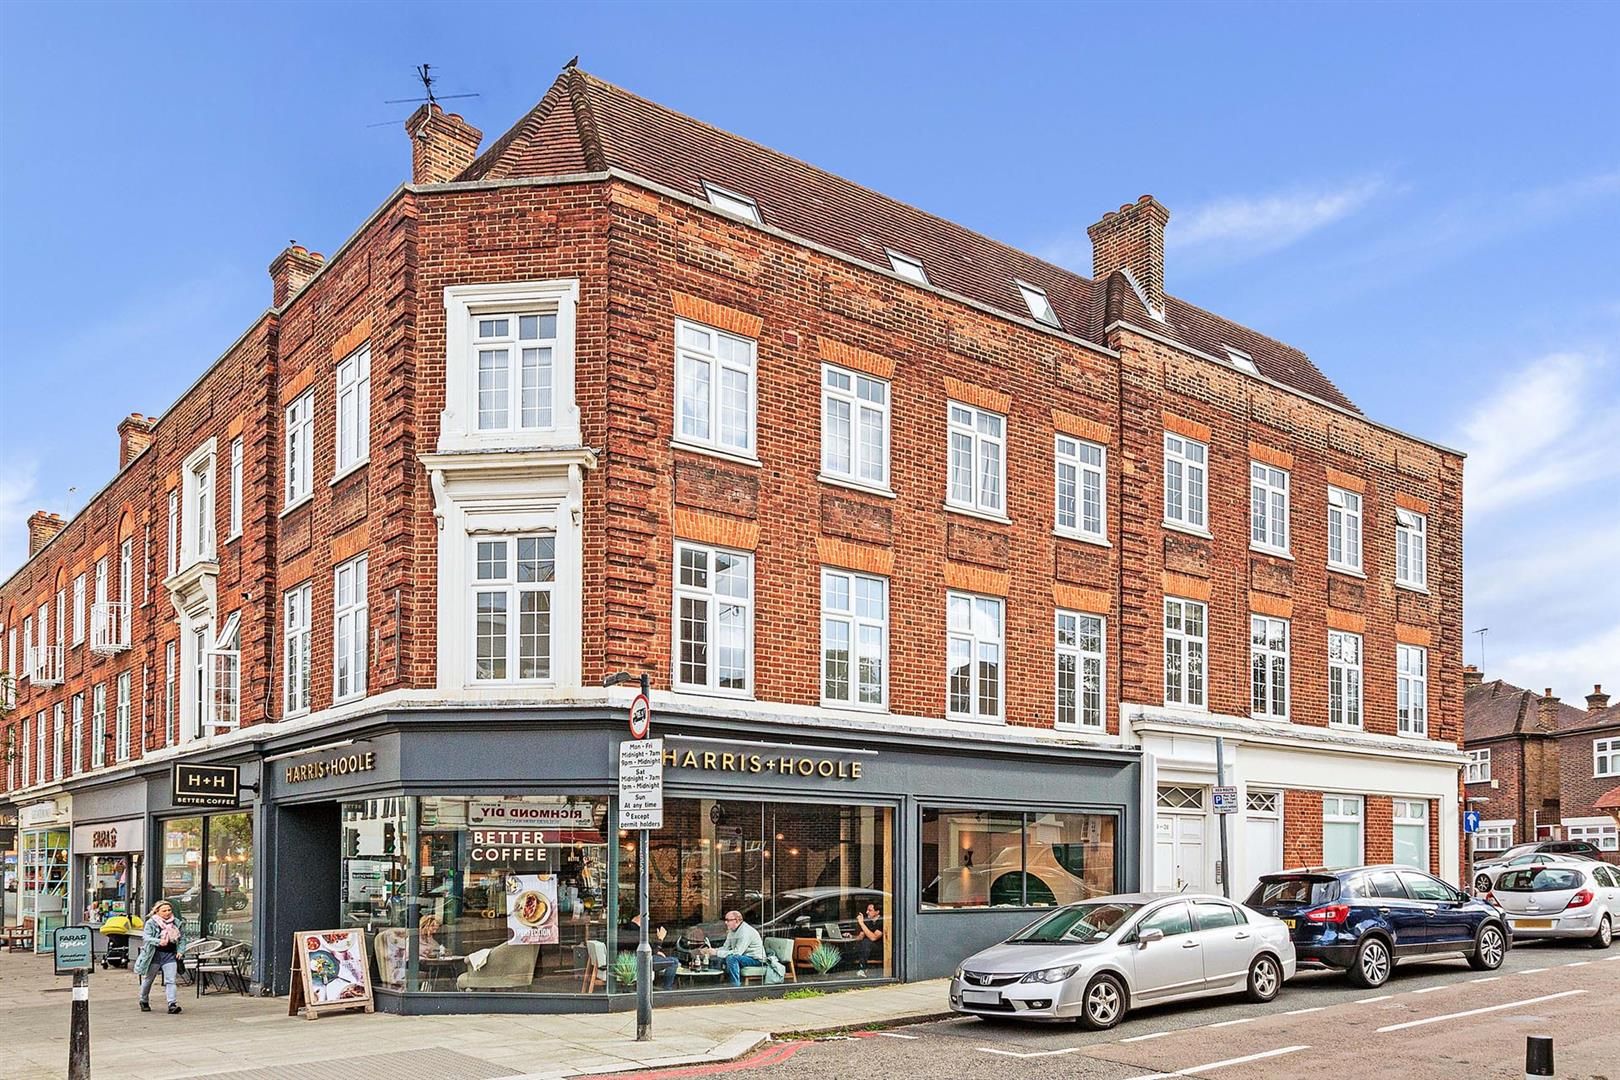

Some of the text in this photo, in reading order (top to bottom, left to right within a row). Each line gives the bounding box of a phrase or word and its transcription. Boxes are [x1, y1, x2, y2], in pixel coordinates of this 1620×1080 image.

[637, 758, 660, 766] Midnight
[621, 775, 644, 783] Midnight
[636, 782, 660, 790] Midnight
[177, 796, 235, 805] BETTER COFFEE
[474, 832, 544, 844] BETTER
[471, 848, 547, 862] COFFEE
[208, 921, 233, 937] COFFEE
[59, 941, 87, 949] open
